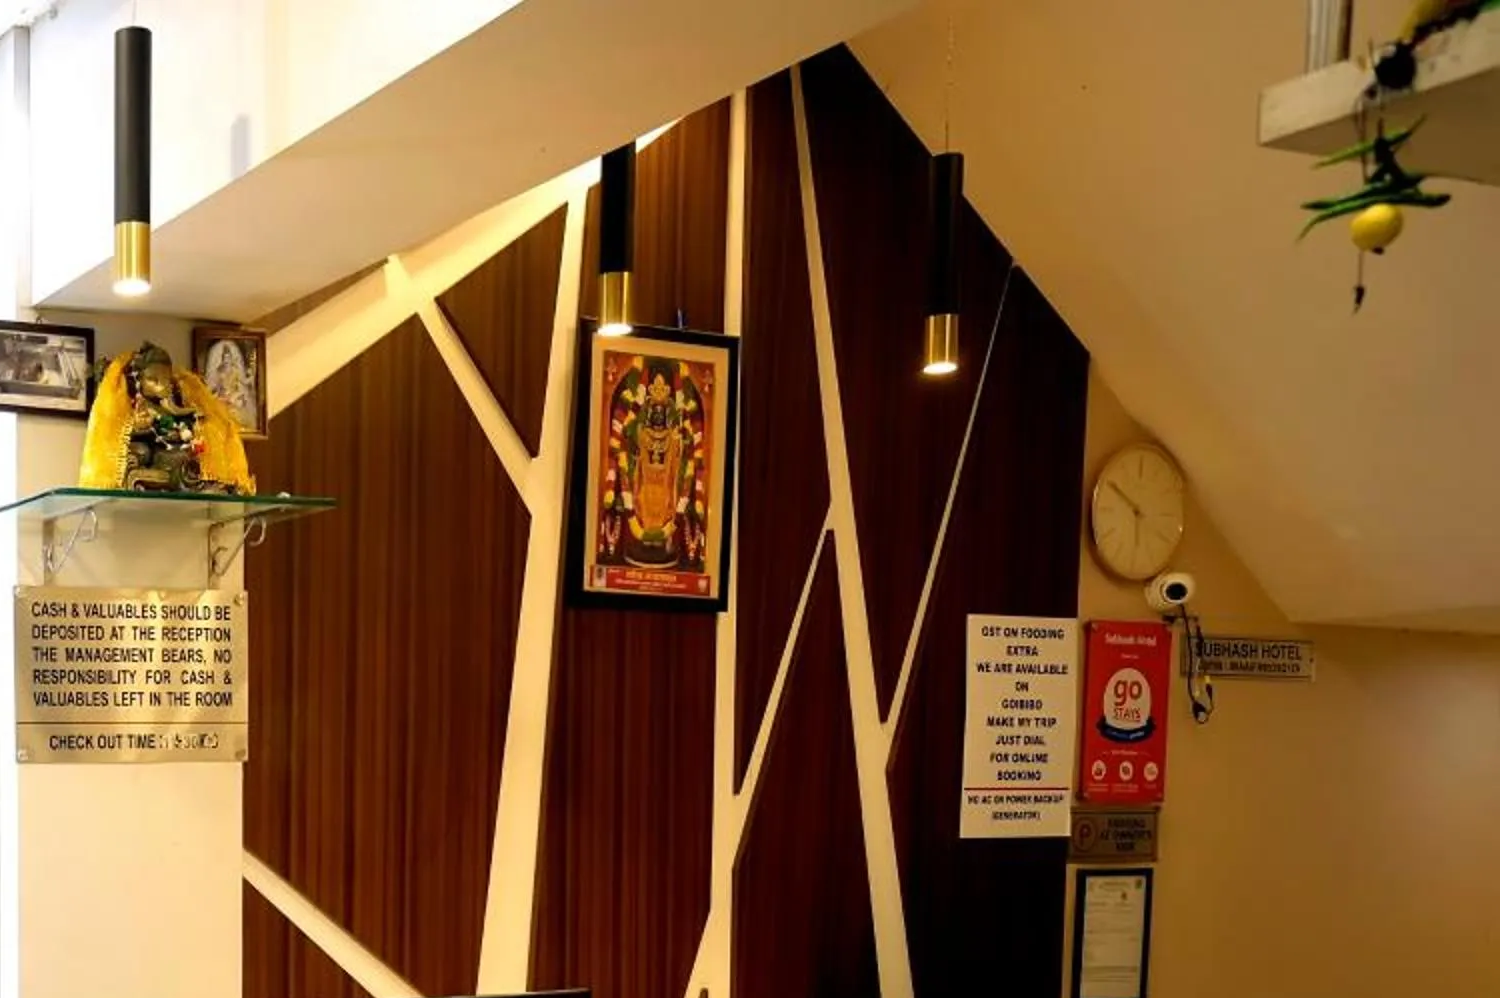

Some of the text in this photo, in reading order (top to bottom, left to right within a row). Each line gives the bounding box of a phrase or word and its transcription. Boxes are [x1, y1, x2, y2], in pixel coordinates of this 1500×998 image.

[31, 602, 231, 621] CASH & VALUABLES SHOULD BE
[31, 624, 231, 642] DEPOSITED AT THE RECEPTION
[1003, 626, 1019, 638] ON
[32, 646, 58, 663] THE
[64, 647, 154, 664] MANAGEMENT
[213, 649, 232, 664] NO
[1006, 645, 1039, 657] EXTRA
[1261, 644, 1303, 661] HOTEL
[33, 669, 232, 686] RESPONSIBILITY FOR CASH &
[1015, 663, 1069, 675] AVAILABLE
[33, 691, 233, 708] VALUABLES LEFT IN THE ROOM
[1113, 679, 1143, 707] go
[49, 734, 93, 750] CHECK
[97, 734, 123, 750] OUT
[995, 735, 1021, 745] JUST
